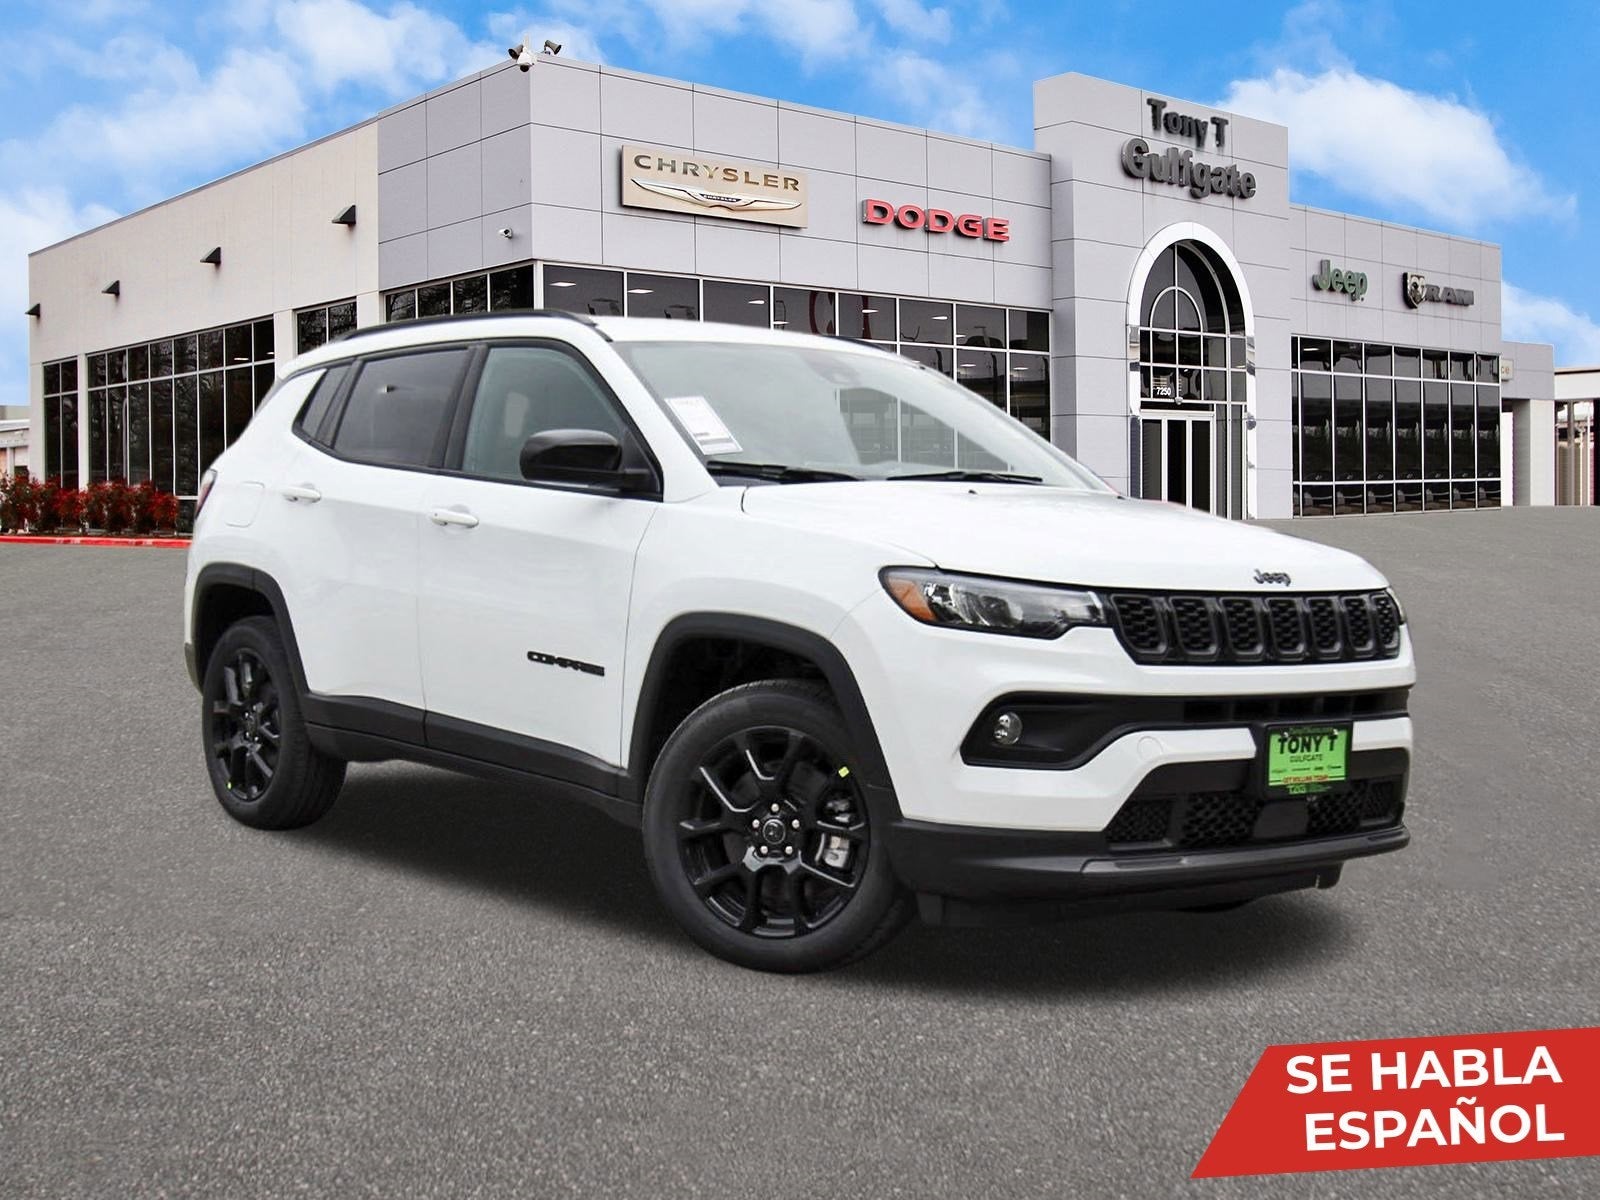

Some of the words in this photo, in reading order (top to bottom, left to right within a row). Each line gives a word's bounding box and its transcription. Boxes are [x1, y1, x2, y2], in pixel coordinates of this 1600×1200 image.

[1146, 98, 1208, 147] Tony
[1210, 116, 1229, 147] T
[633, 154, 800, 191] CHRYSLER
[1121, 138, 1257, 199] Gulfgate
[862, 199, 1010, 242] DODGE
[1312, 259, 1368, 301] Jeep
[1424, 283, 1475, 306] RAM
[1253, 568, 1291, 587] Jeep
[1278, 735, 1325, 754] TONY
[1327, 734, 1339, 752] T
